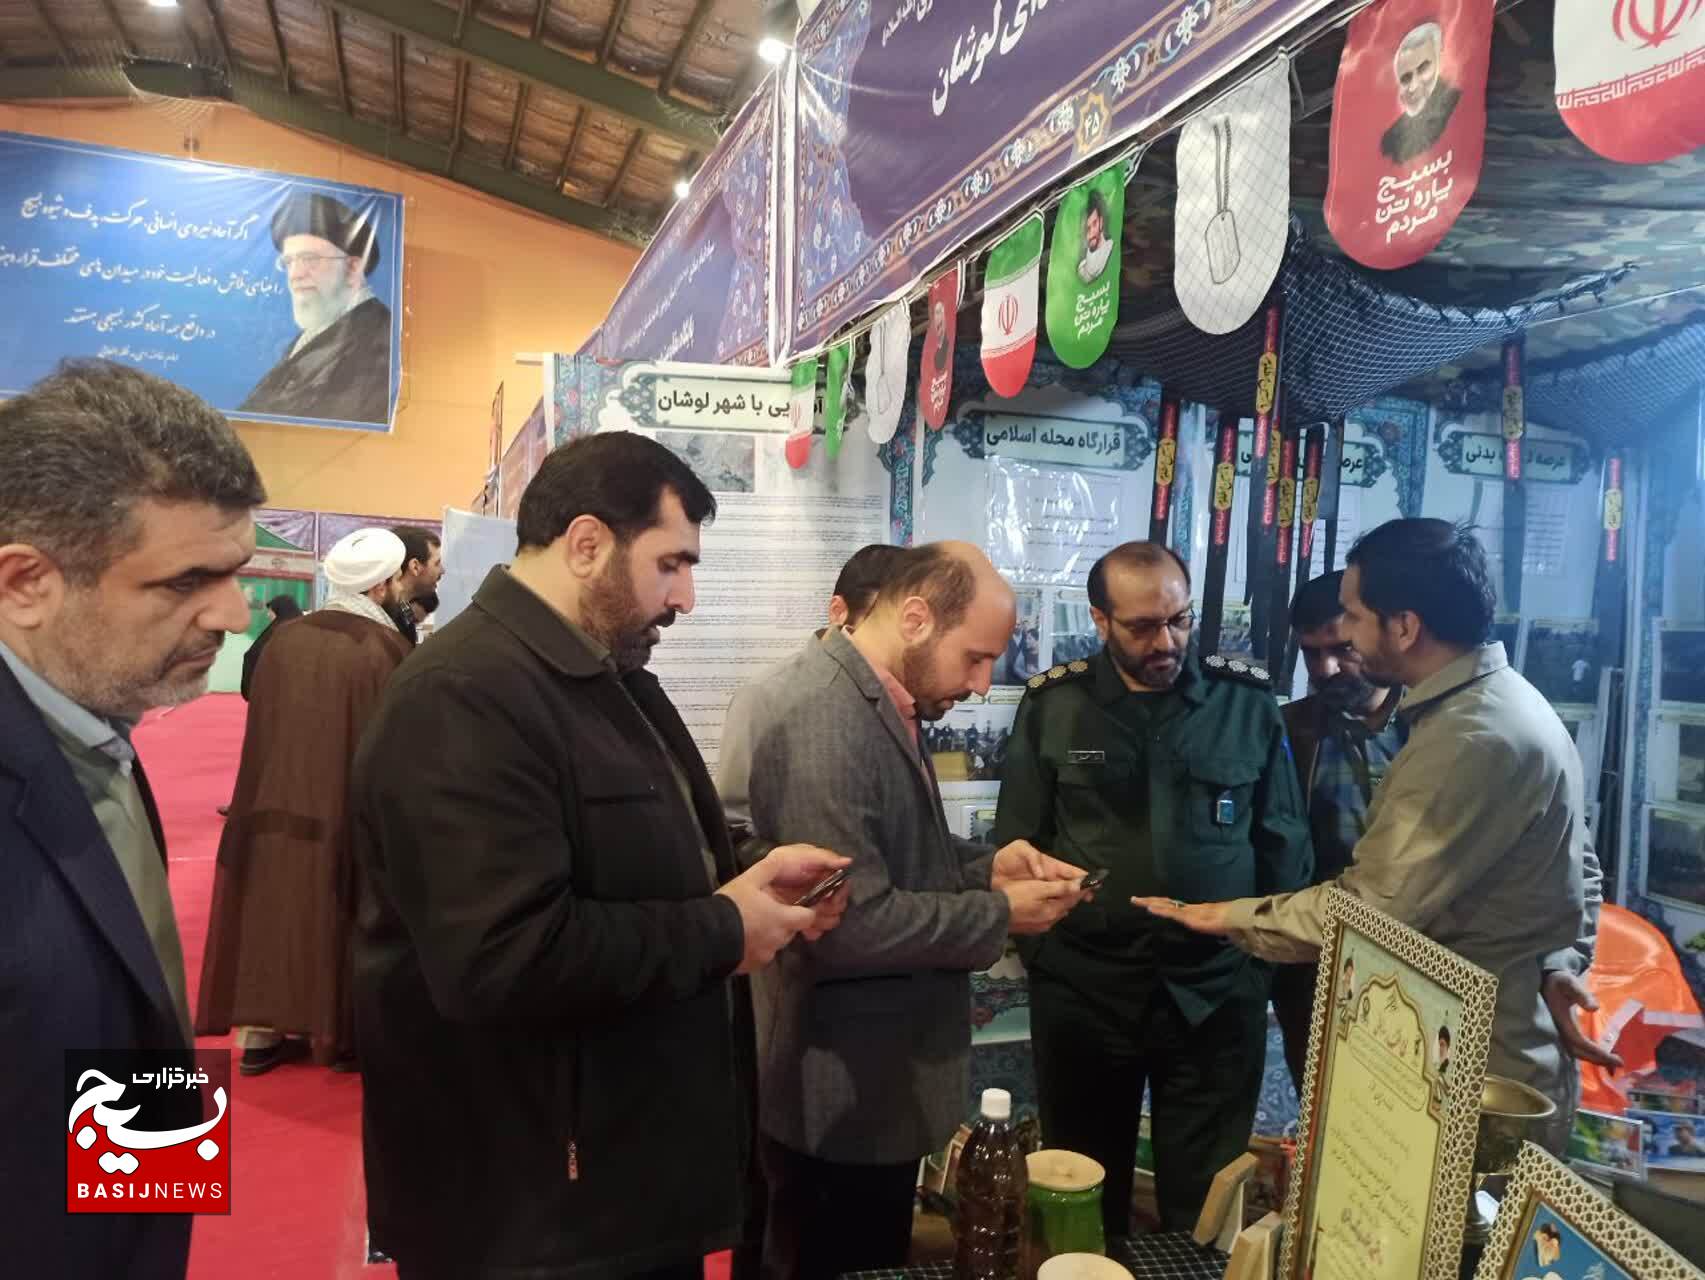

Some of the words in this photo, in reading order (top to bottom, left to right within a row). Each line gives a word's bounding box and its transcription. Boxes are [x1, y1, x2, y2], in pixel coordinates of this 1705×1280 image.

[932, 0, 1003, 116] لوشان
[1376, 149, 1454, 204] بسیج
[21, 191, 42, 219] بسیج
[1413, 177, 1453, 210] پاره
[1375, 197, 1410, 224] تن
[176, 218, 214, 239] نیروی
[233, 212, 260, 240] اگر
[1385, 205, 1439, 244] مردم
[102, 264, 139, 284] میدان
[166, 264, 212, 288] فعالیت
[217, 269, 249, 294] تلاش
[1075, 280, 1111, 313] بسیج
[123, 303, 160, 329] کشور
[178, 313, 205, 342] واقع
[657, 390, 711, 413] لوشان
[713, 393, 746, 415] شهر
[751, 394, 763, 416] با
[986, 424, 1037, 446] اسلامی
[1040, 427, 1075, 447] محله
[1078, 431, 1121, 456] قرارگاه
[1465, 445, 1496, 465] بدنی
